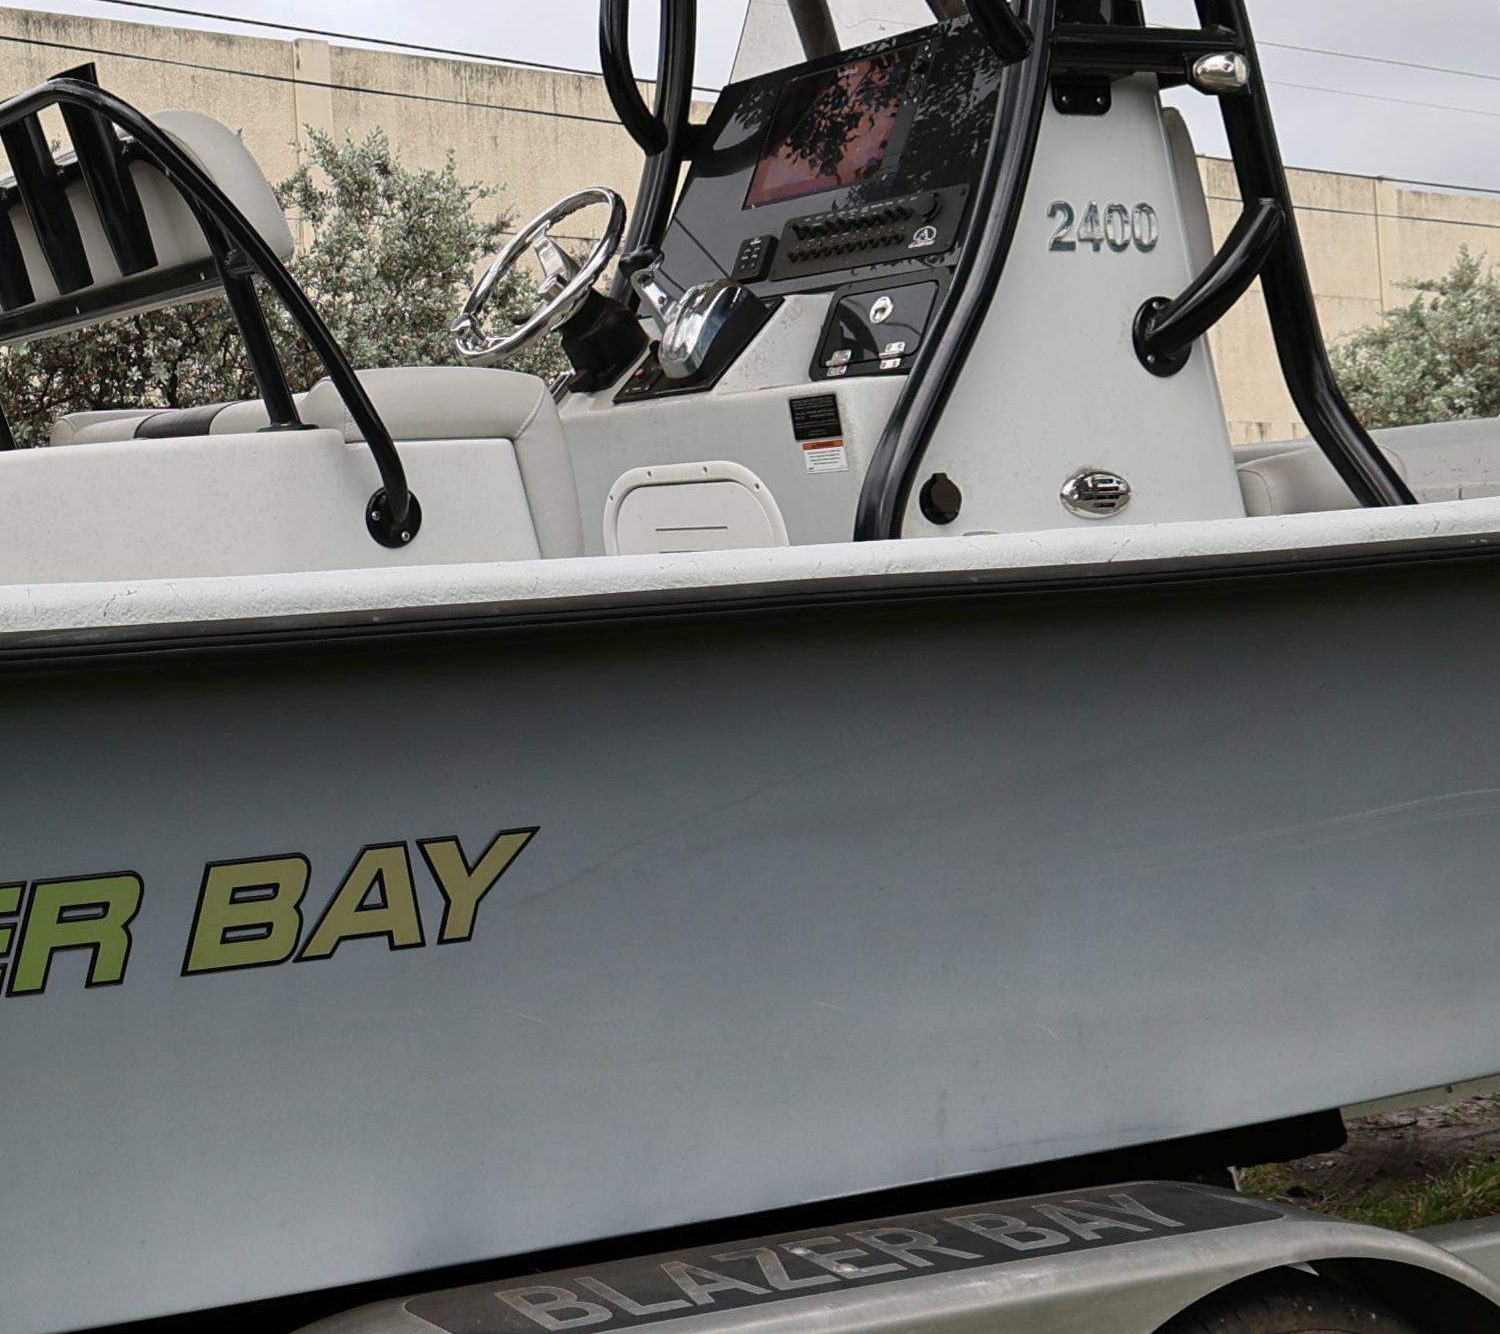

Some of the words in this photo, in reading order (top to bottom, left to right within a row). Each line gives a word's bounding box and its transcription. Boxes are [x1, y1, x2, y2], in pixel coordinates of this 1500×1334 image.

[1047, 200, 1159, 253] 2400
[181, 826, 541, 977] BAY
[494, 1226, 984, 1332] BLAZER
[944, 1192, 1185, 1252] BAY
